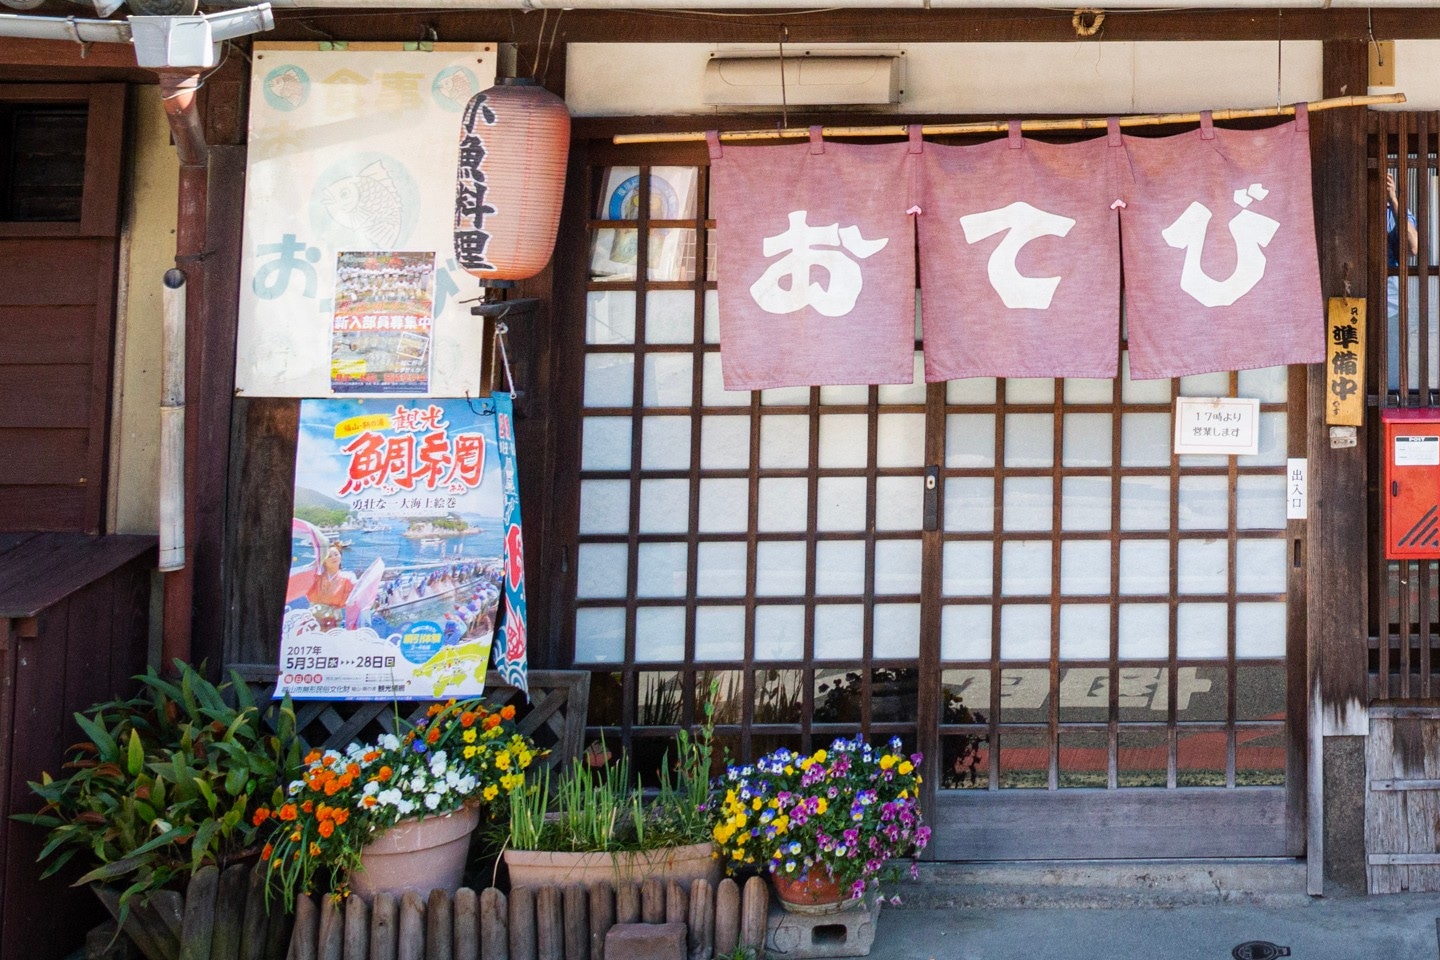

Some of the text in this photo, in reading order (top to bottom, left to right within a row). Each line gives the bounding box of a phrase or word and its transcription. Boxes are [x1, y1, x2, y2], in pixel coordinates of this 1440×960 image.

[453, 93, 500, 271] 小魚料理
[749, 183, 1281, 317] おてび
[334, 315, 432, 330] 新入部員募集中
[1331, 324, 1359, 401] 準備中
[392, 406, 448, 430] 観光
[1192, 427, 1240, 437] 営業します
[339, 432, 484, 495] 鯛網
[352, 498, 457, 510] 勇壮な一大海上絵巻
[1291, 469, 1303, 508] 出入口
[287, 646, 322, 655] 2017年
